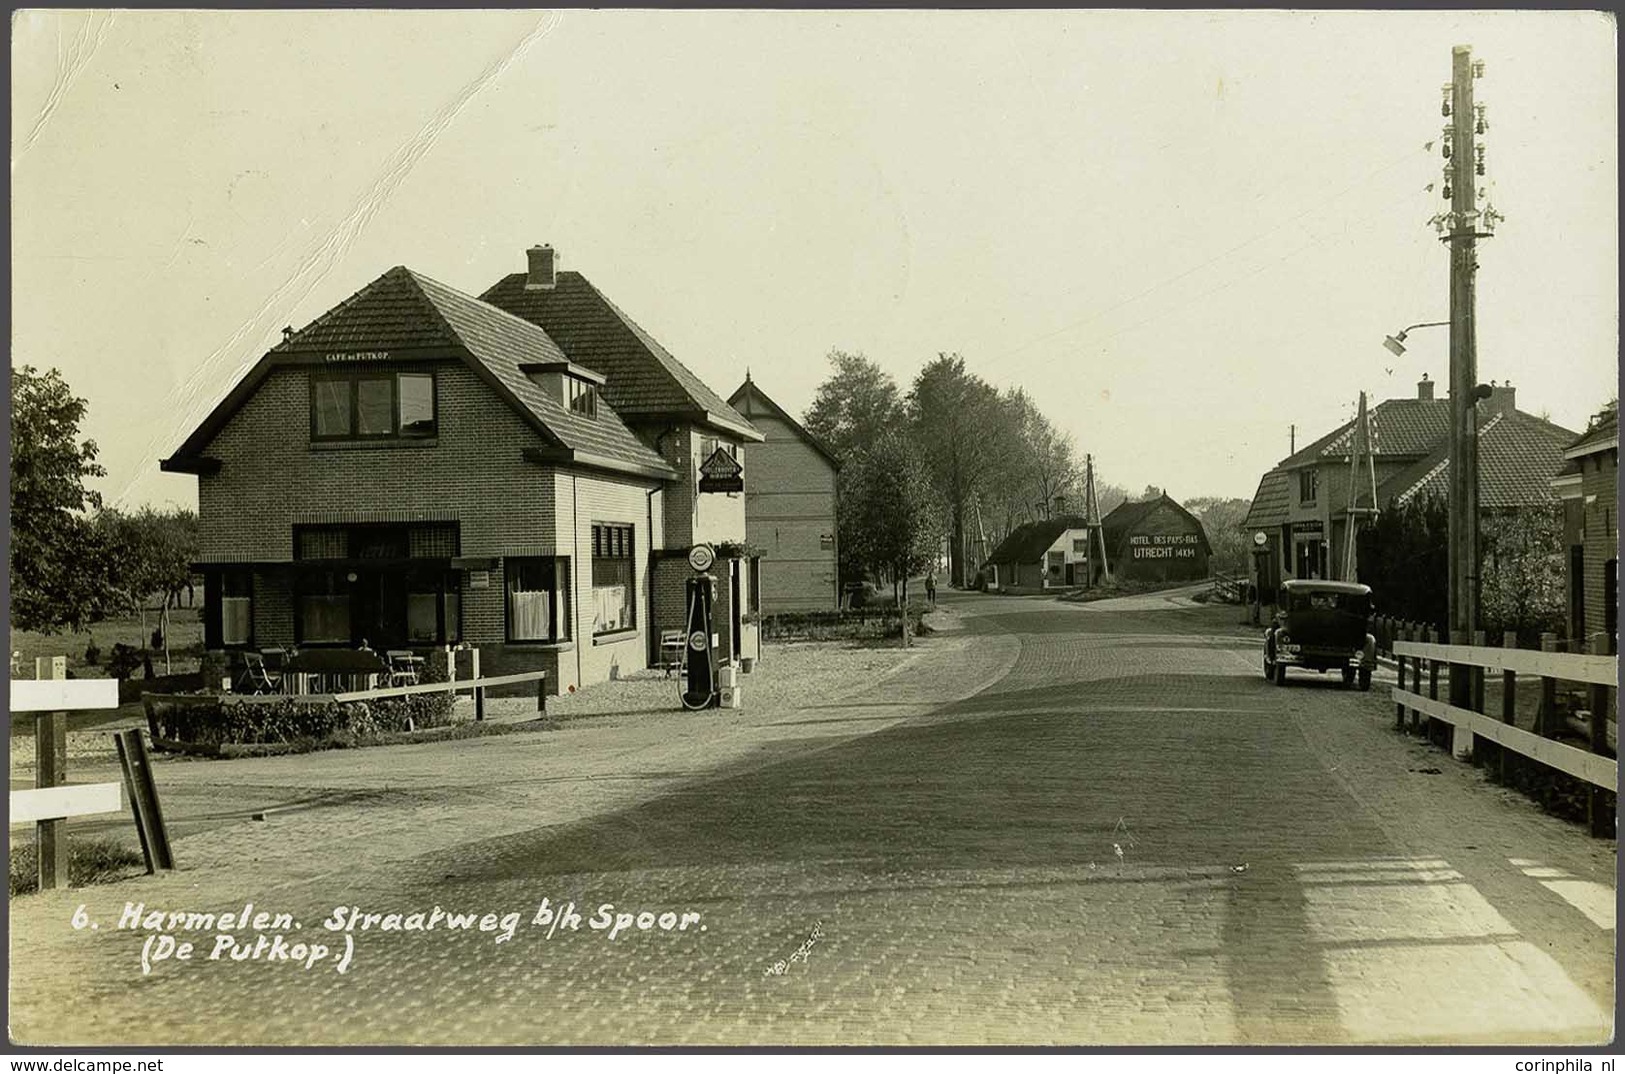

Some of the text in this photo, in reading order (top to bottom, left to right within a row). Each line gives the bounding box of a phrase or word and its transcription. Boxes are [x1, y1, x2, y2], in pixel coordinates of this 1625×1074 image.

[1130, 534, 1198, 545] HOTEL DES PAYS-BAS
[1133, 546, 1173, 559] UTRECHT
